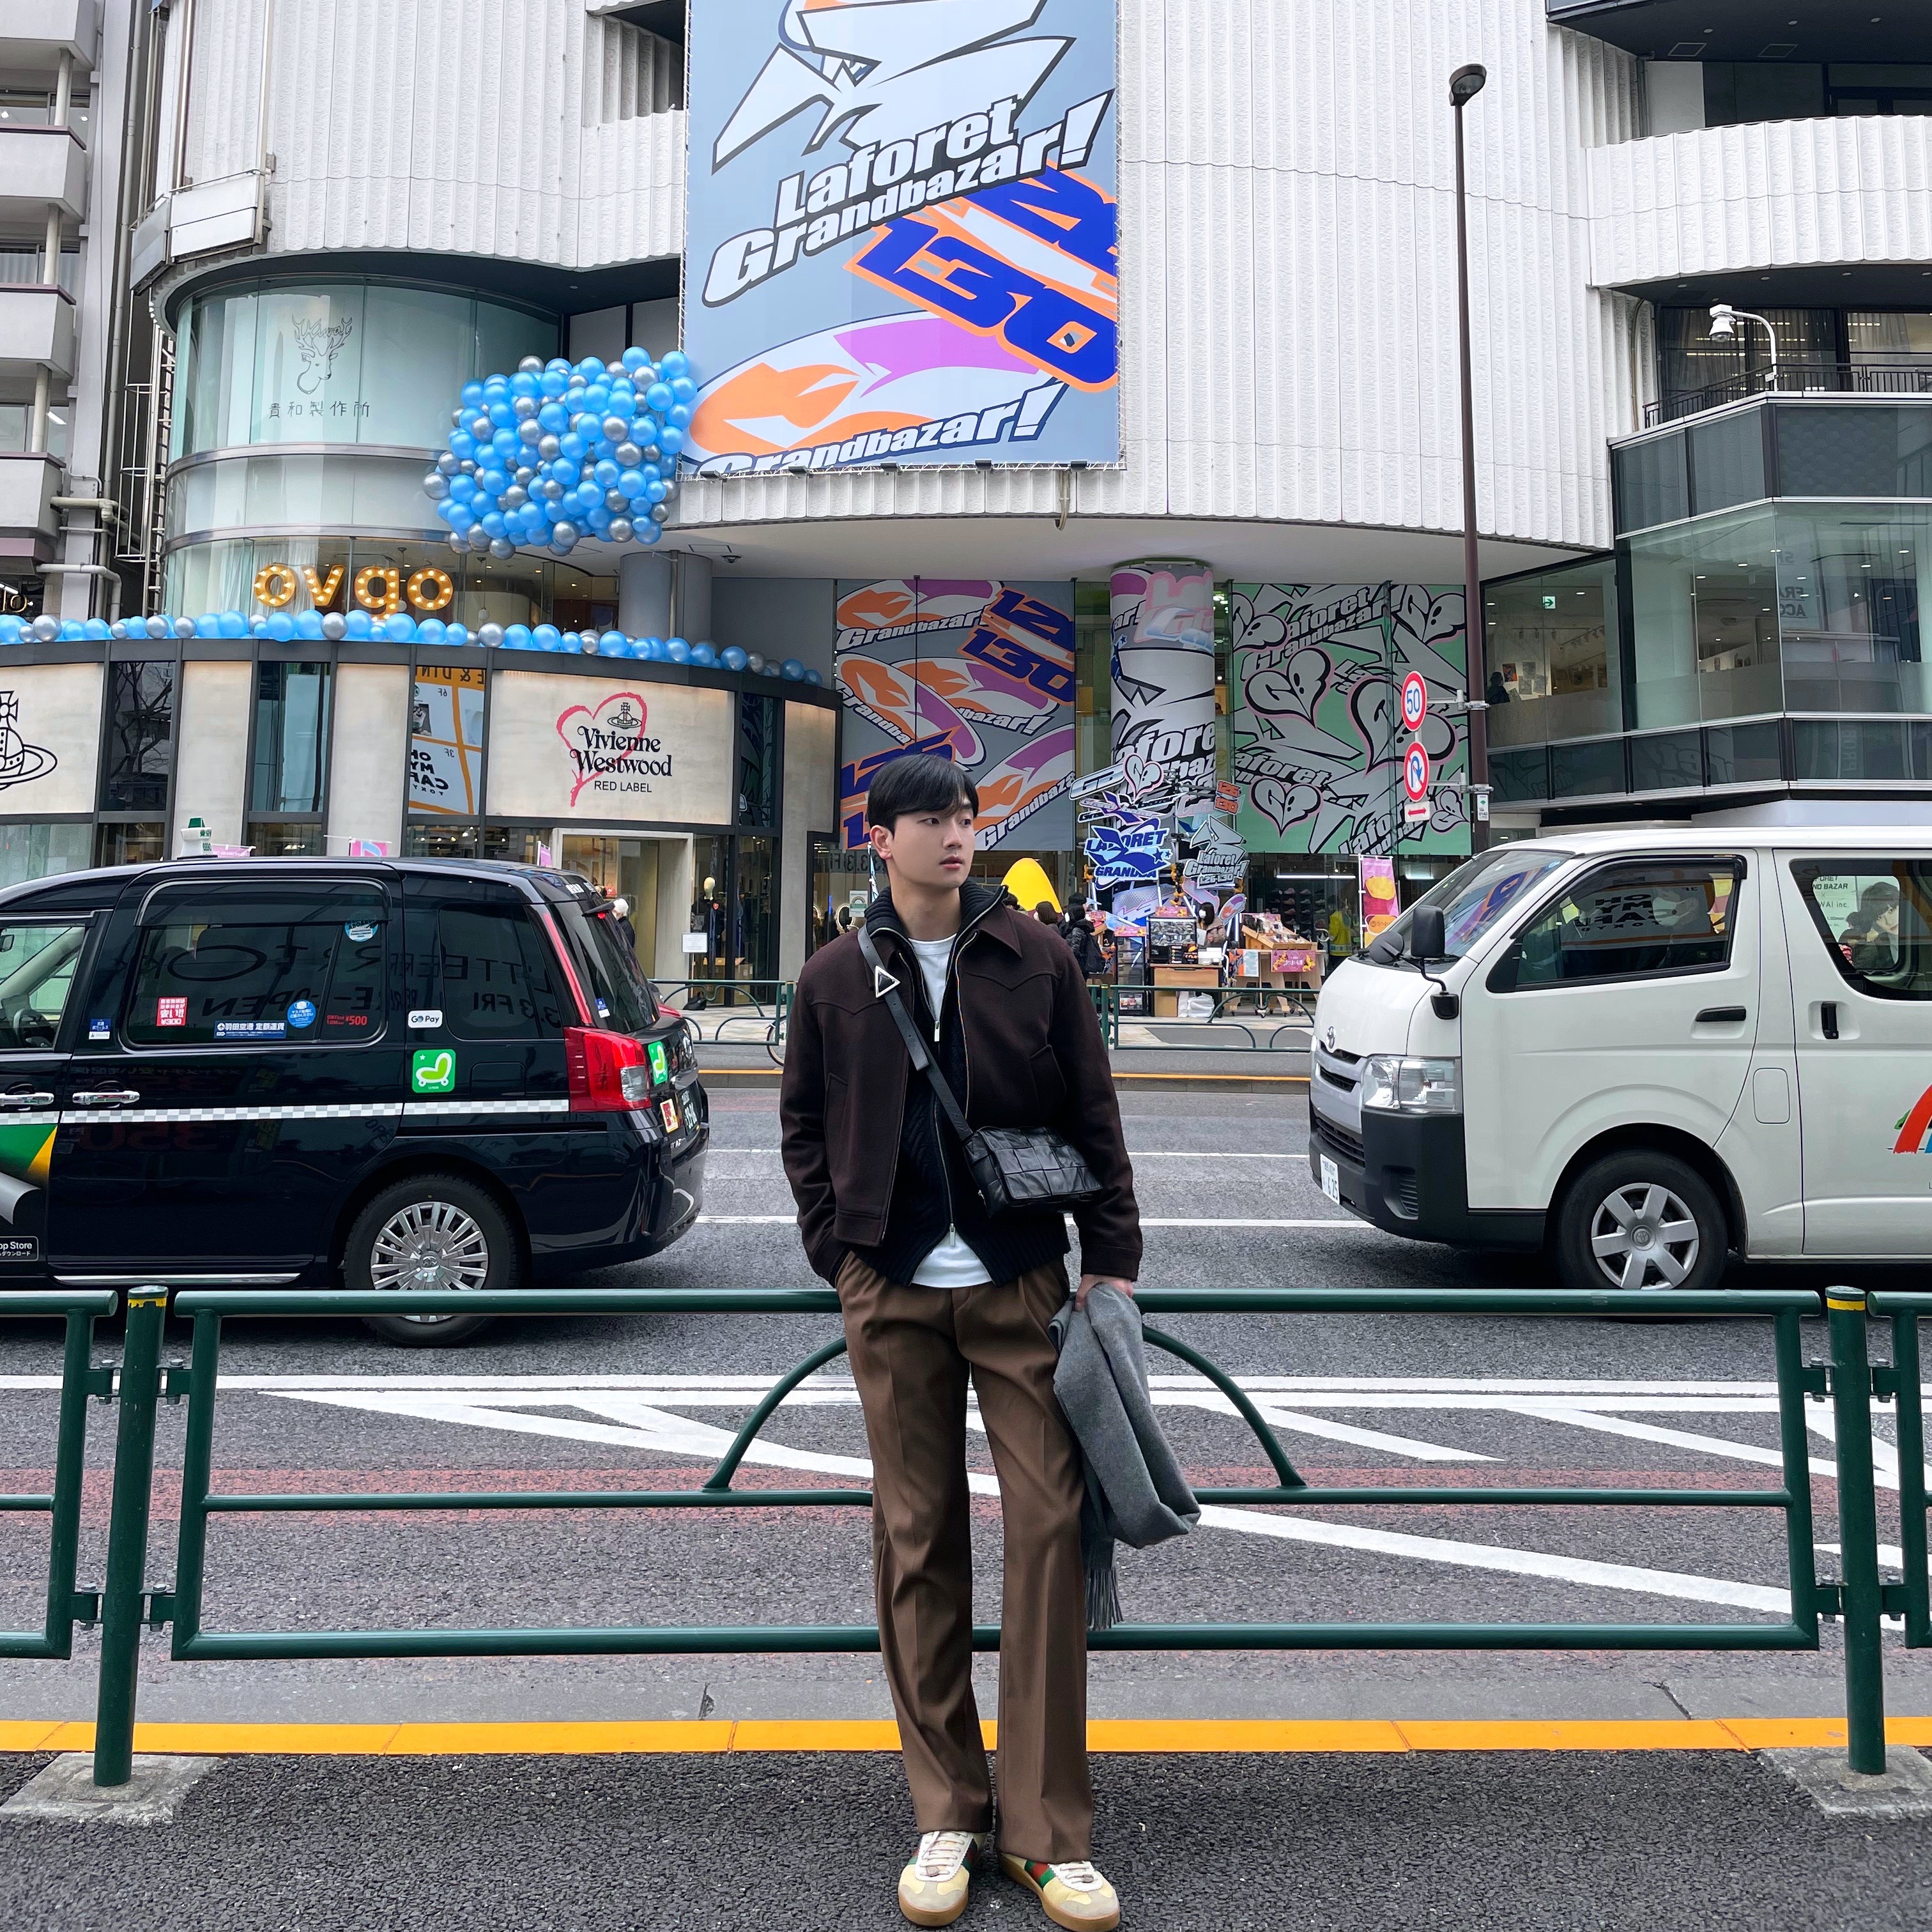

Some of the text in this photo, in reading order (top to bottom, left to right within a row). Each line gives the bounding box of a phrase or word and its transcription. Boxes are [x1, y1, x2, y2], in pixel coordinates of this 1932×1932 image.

[774, 94, 1027, 229] Laforet
[702, 88, 1116, 308] Grandbazar!
[269, 401, 371, 419] 貴和製作所
[254, 563, 454, 621] ovgo
[1287, 586, 1372, 640] aforet
[1406, 688, 1420, 714] 50
[577, 725, 661, 752] Vivienne
[569, 748, 673, 777] Westwood
[594, 780, 653, 793] RED LABEL
[1184, 861, 1250, 878] Grandbazar!
[1199, 850, 1237, 866] Laforet
[425, 1015, 440, 1023] Pay
[10, 1241, 32, 1250] Store
